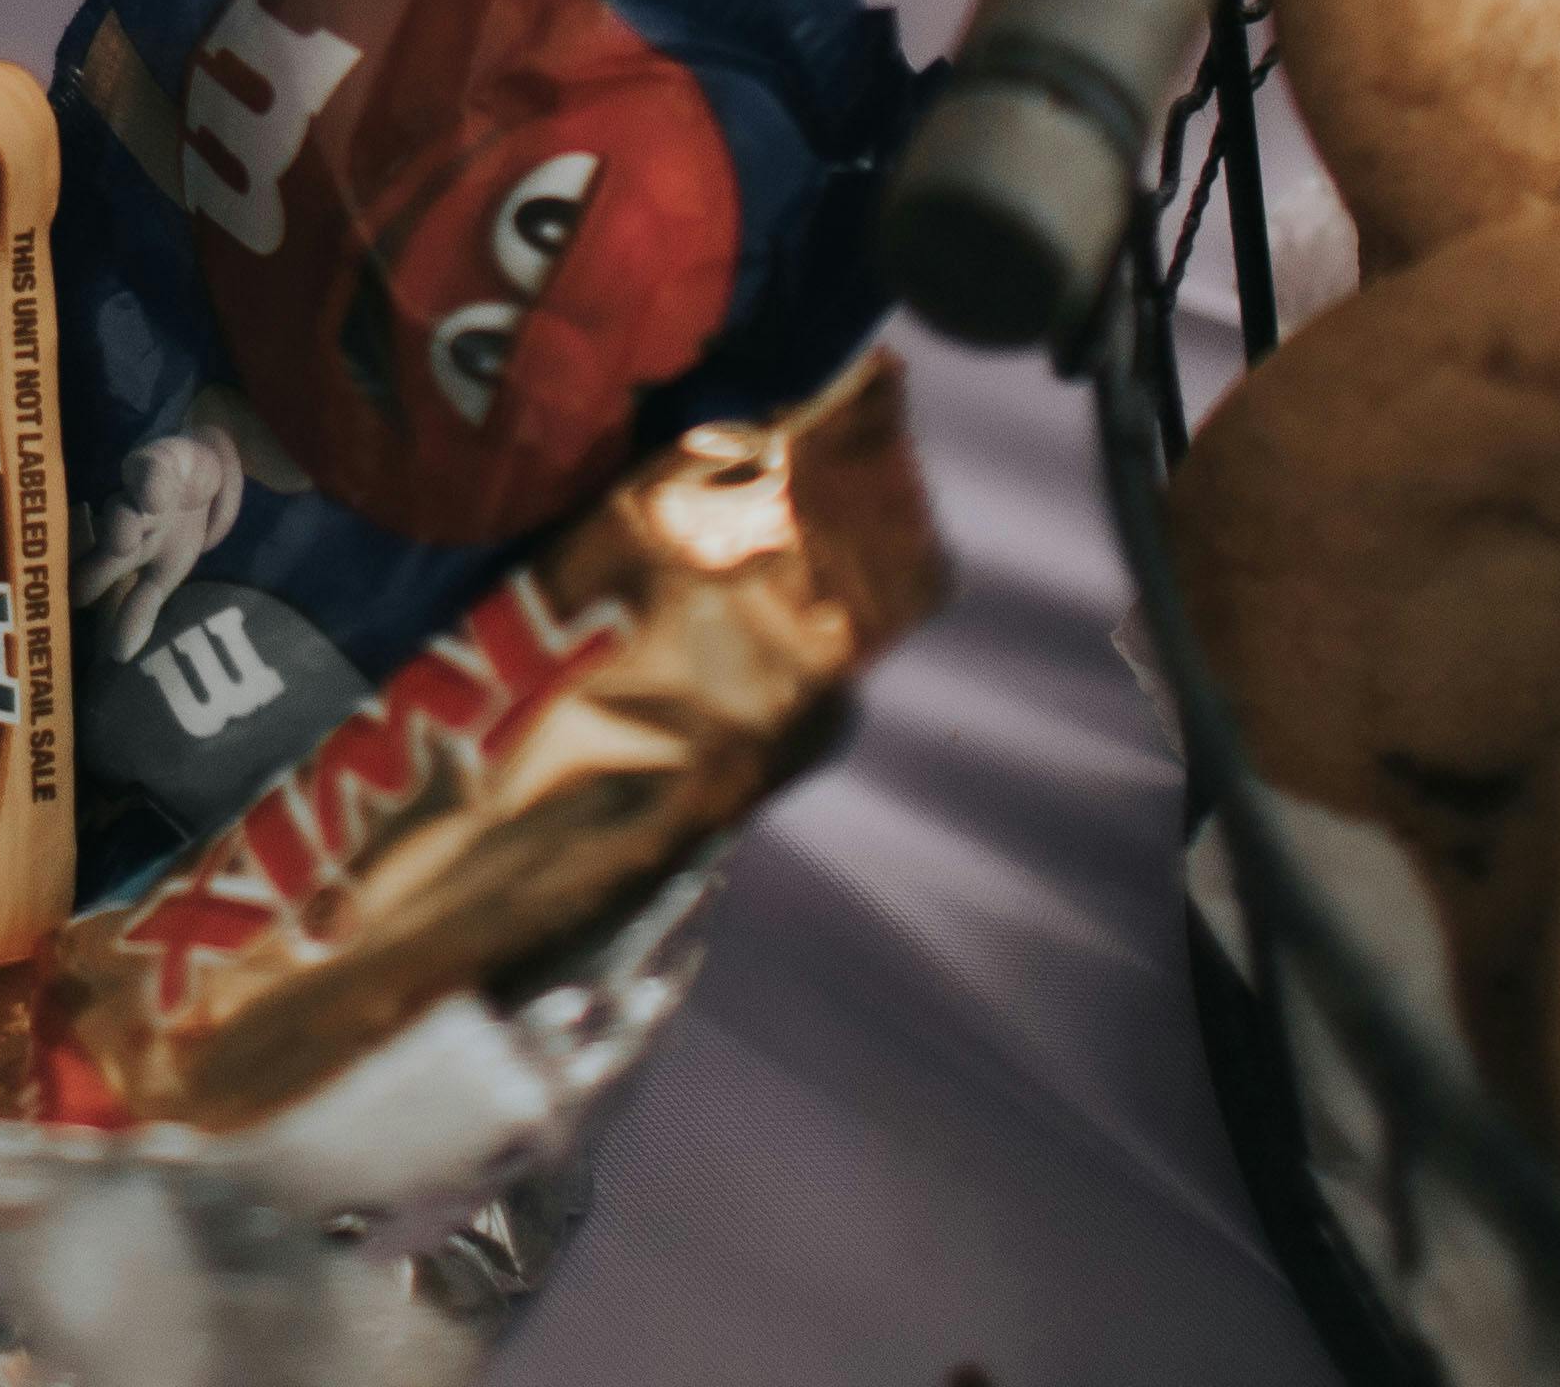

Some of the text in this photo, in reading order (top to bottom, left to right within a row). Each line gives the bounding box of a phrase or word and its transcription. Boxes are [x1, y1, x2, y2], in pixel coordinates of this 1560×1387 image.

[12, 225, 57, 805] THIS UNIT NOT LABELED FOR RETAIL SALE
[140, 604, 285, 740] m
[121, 570, 626, 1017] TWIX
